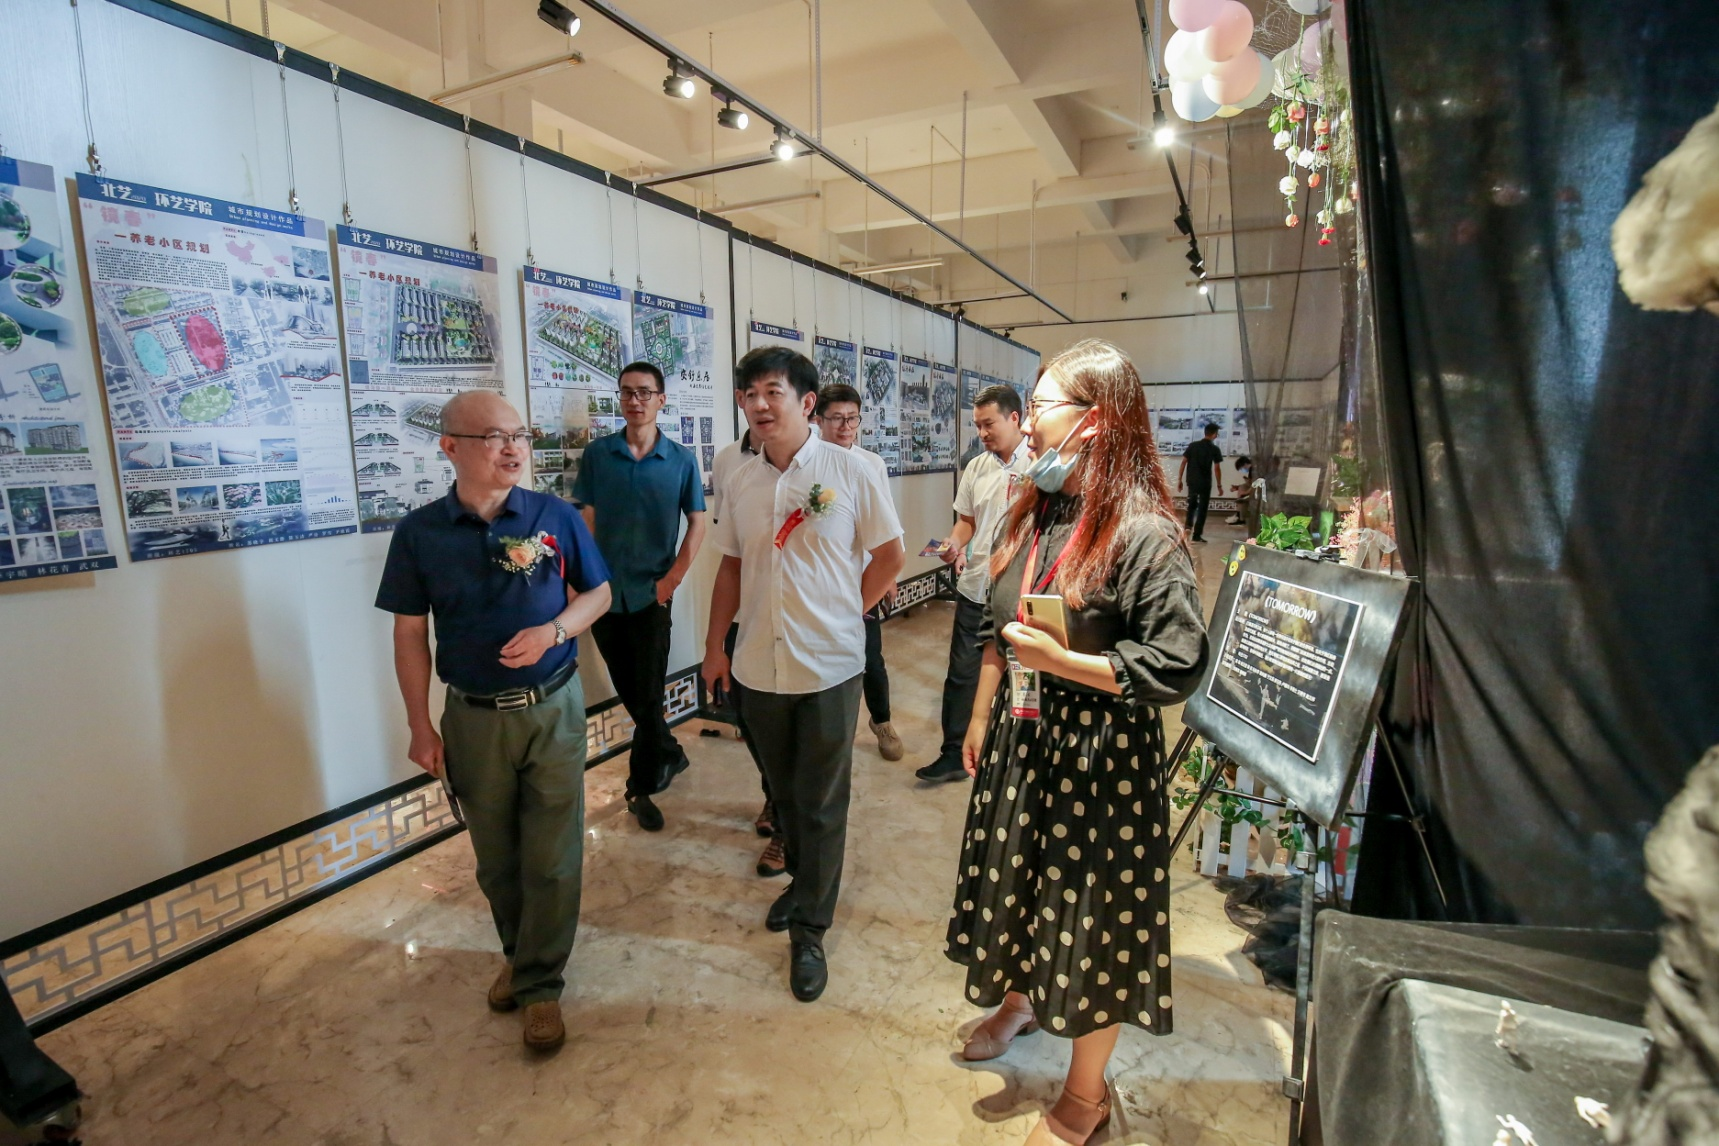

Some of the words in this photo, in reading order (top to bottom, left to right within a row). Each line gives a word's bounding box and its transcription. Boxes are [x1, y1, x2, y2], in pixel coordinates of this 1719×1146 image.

[154, 191, 213, 217] 环艺学院
[227, 205, 294, 225] 城市规划设计作品
[385, 238, 424, 256] 环艺学院
